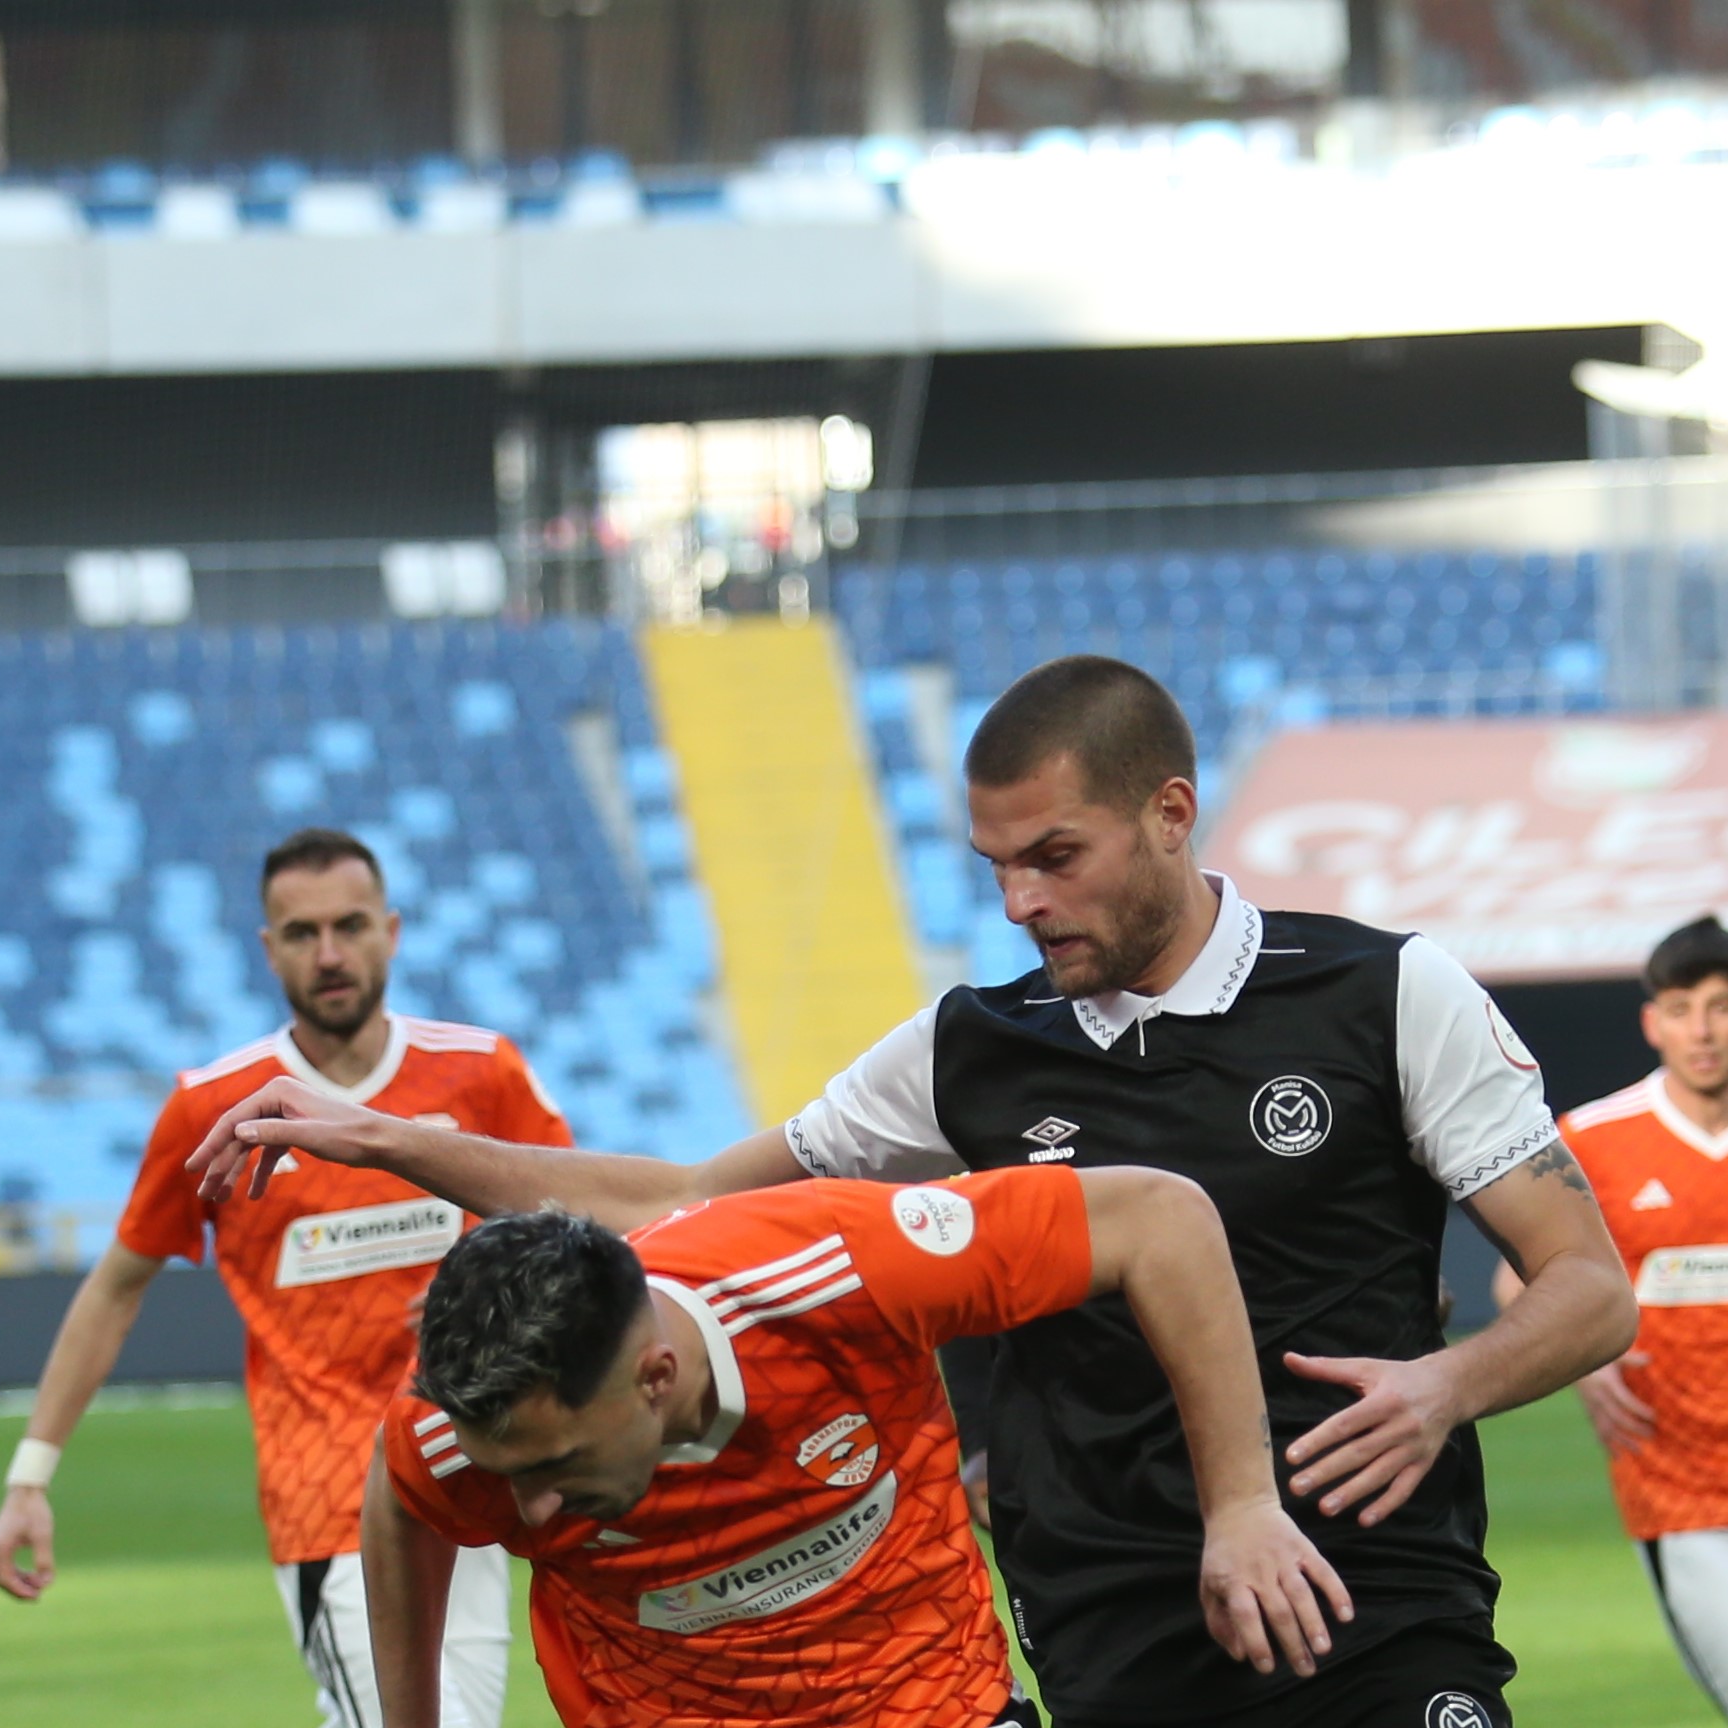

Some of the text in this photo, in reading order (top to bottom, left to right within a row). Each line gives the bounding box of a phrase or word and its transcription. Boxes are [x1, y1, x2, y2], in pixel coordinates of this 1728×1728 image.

[672, 1515, 888, 1633] VIENNA INSURANCE GROUP
[702, 1500, 881, 1600] Viennalife
